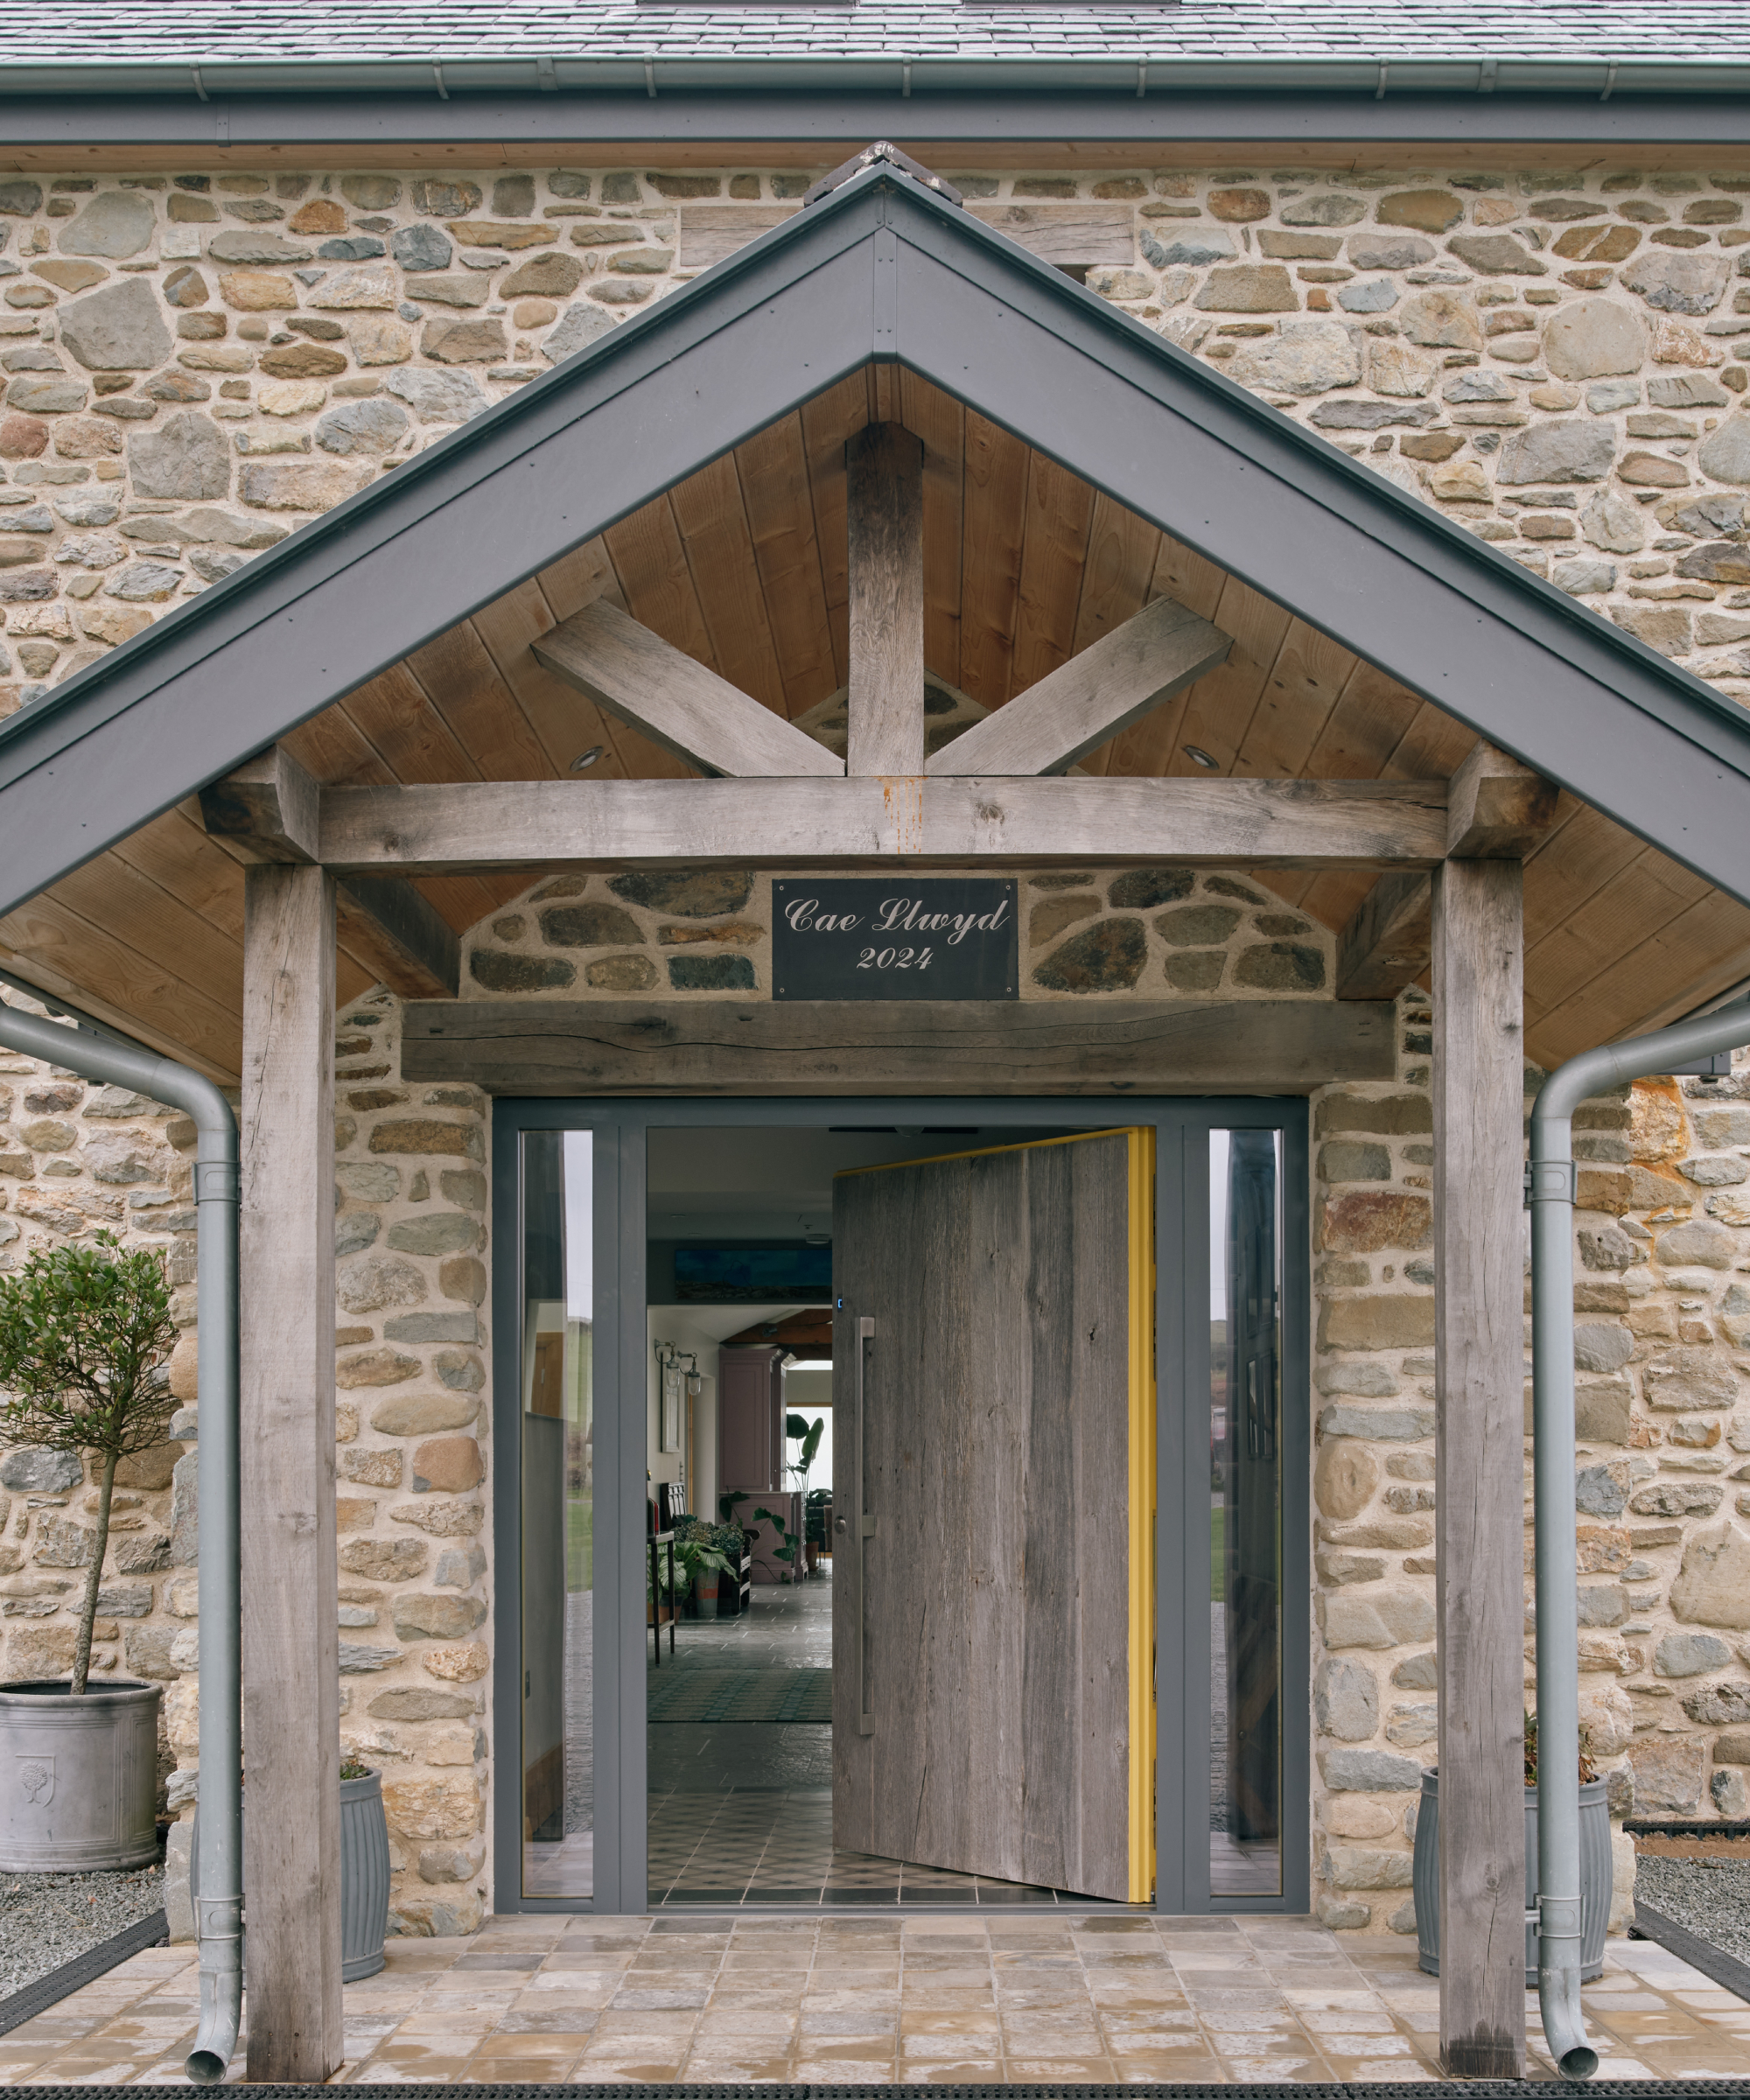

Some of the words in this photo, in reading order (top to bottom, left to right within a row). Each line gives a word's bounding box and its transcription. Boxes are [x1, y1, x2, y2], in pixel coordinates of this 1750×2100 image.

[785, 899, 865, 932] Cae
[872, 898, 1010, 945] Llwyd
[857, 947, 934, 970] 2024
